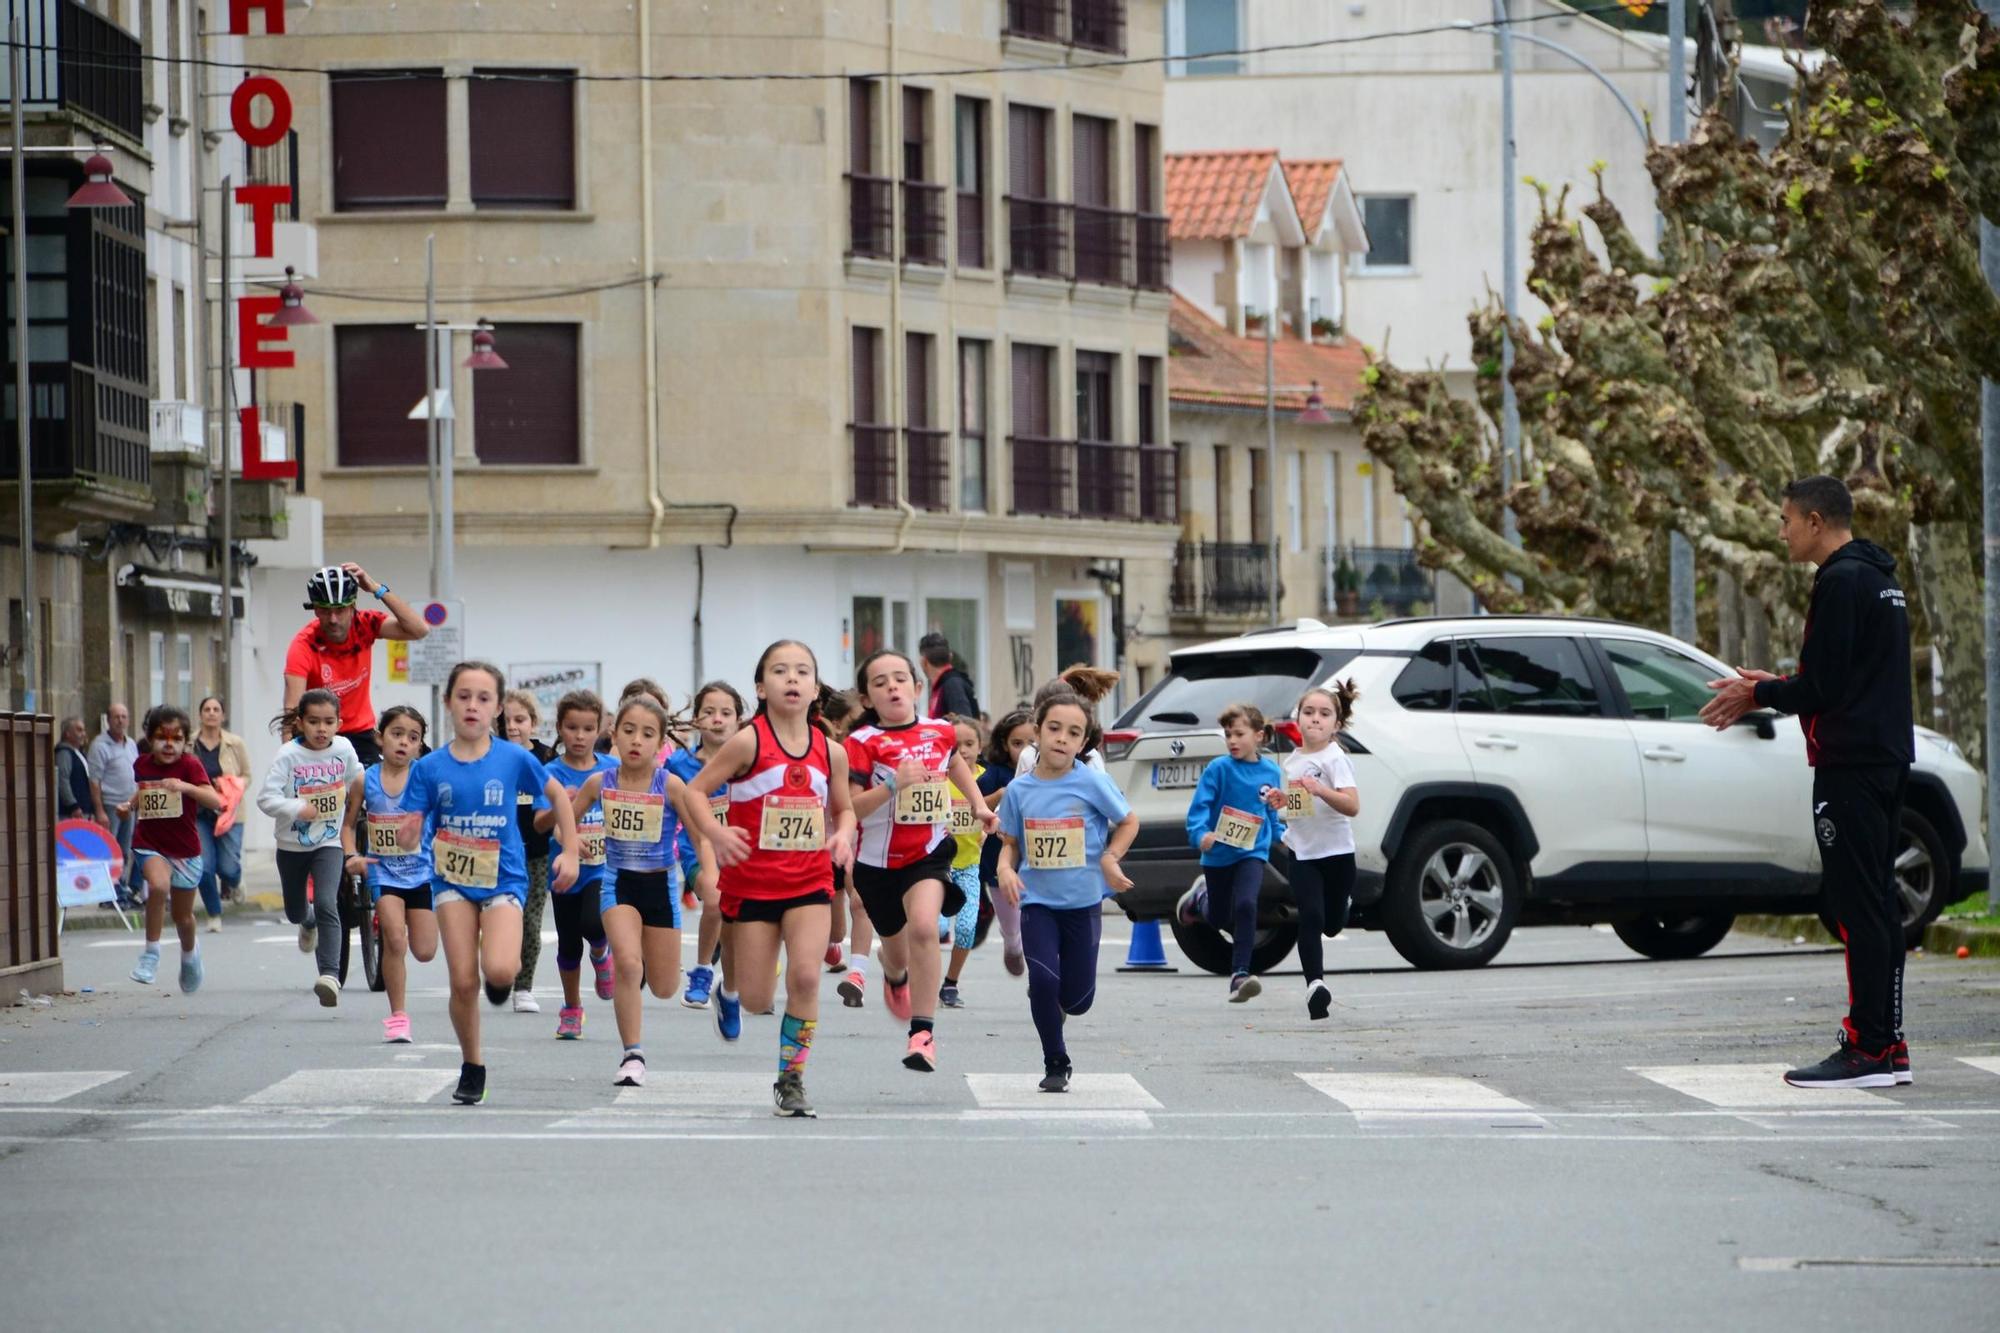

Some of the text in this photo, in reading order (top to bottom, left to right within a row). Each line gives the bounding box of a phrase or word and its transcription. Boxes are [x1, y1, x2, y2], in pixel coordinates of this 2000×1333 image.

[1158, 765, 1187, 783] 0201
[144, 793, 168, 811] 382
[912, 790, 943, 813] 364
[1288, 793, 1302, 810] 86
[611, 808, 645, 831] 365
[778, 817, 814, 840] 374
[1226, 821, 1251, 841] 377
[1034, 837, 1067, 858] 372
[446, 851, 475, 876] 371
